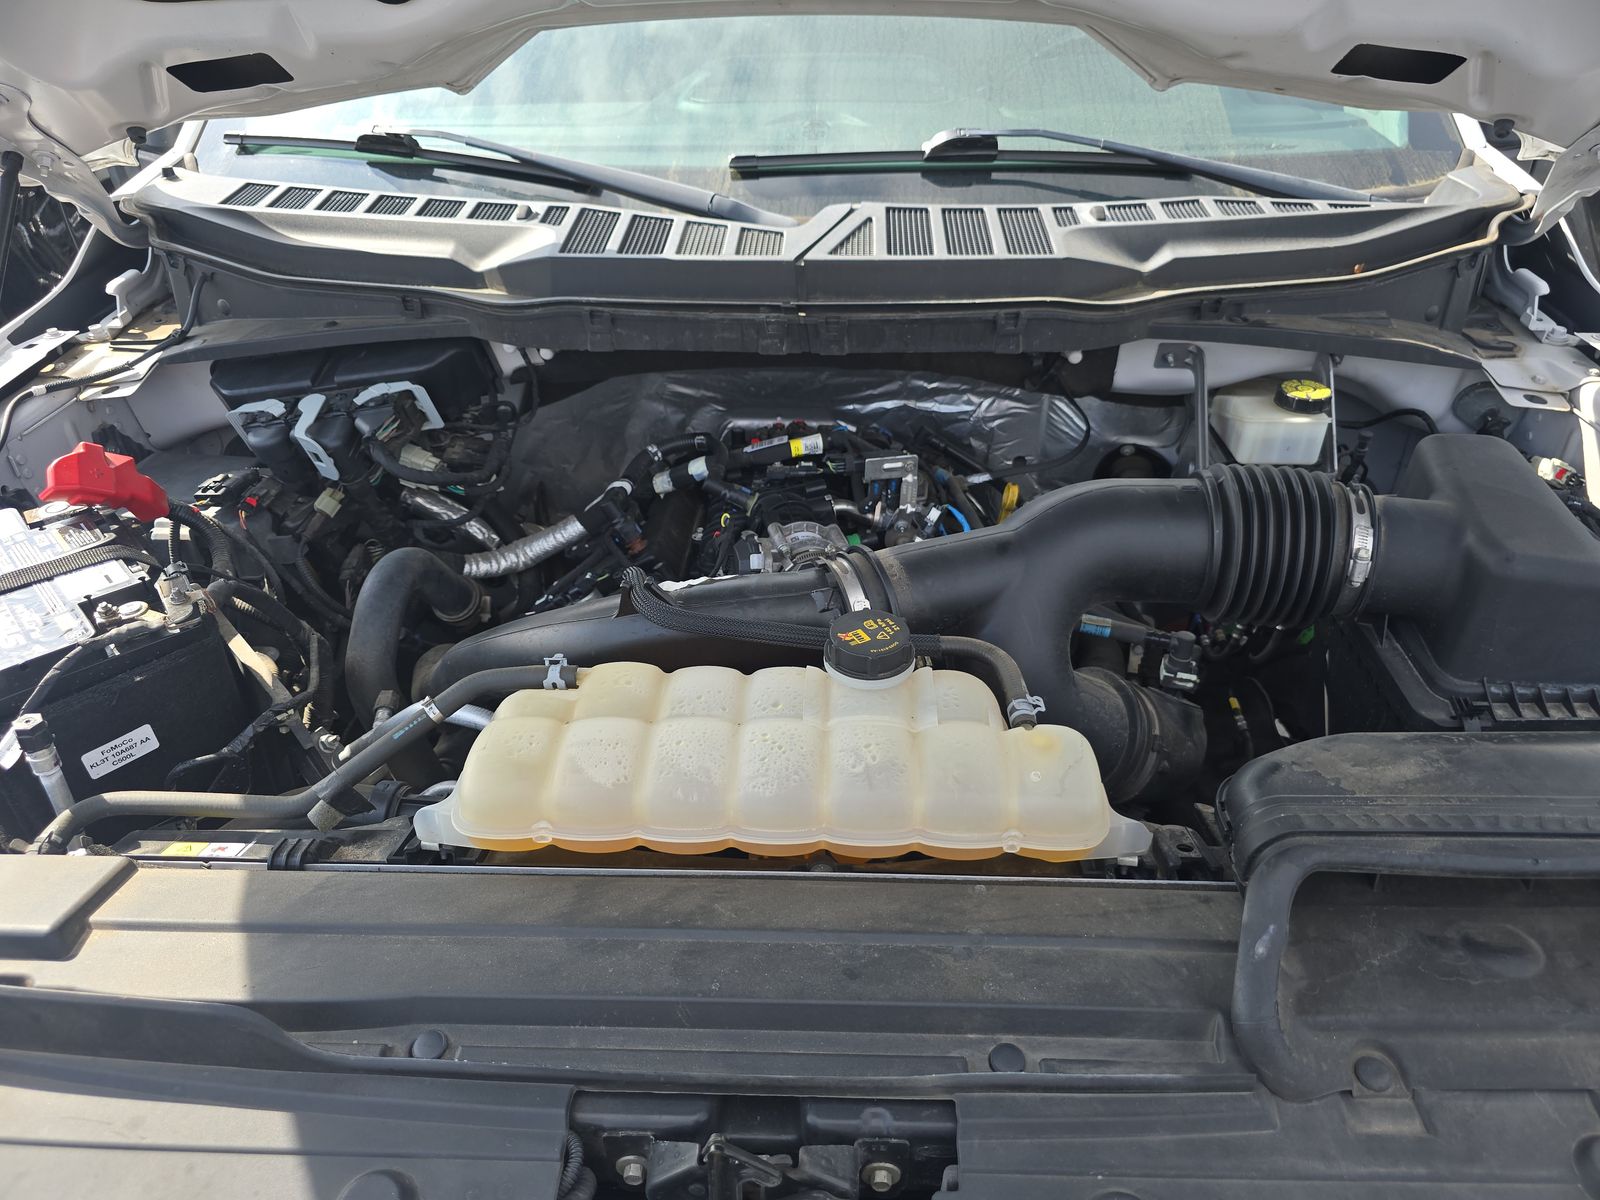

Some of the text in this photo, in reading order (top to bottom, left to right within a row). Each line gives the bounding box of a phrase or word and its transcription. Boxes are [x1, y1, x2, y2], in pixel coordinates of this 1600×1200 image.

[89, 736, 151, 770] KL3T 10A687 AA
[101, 738, 133, 756] FoMoCo
